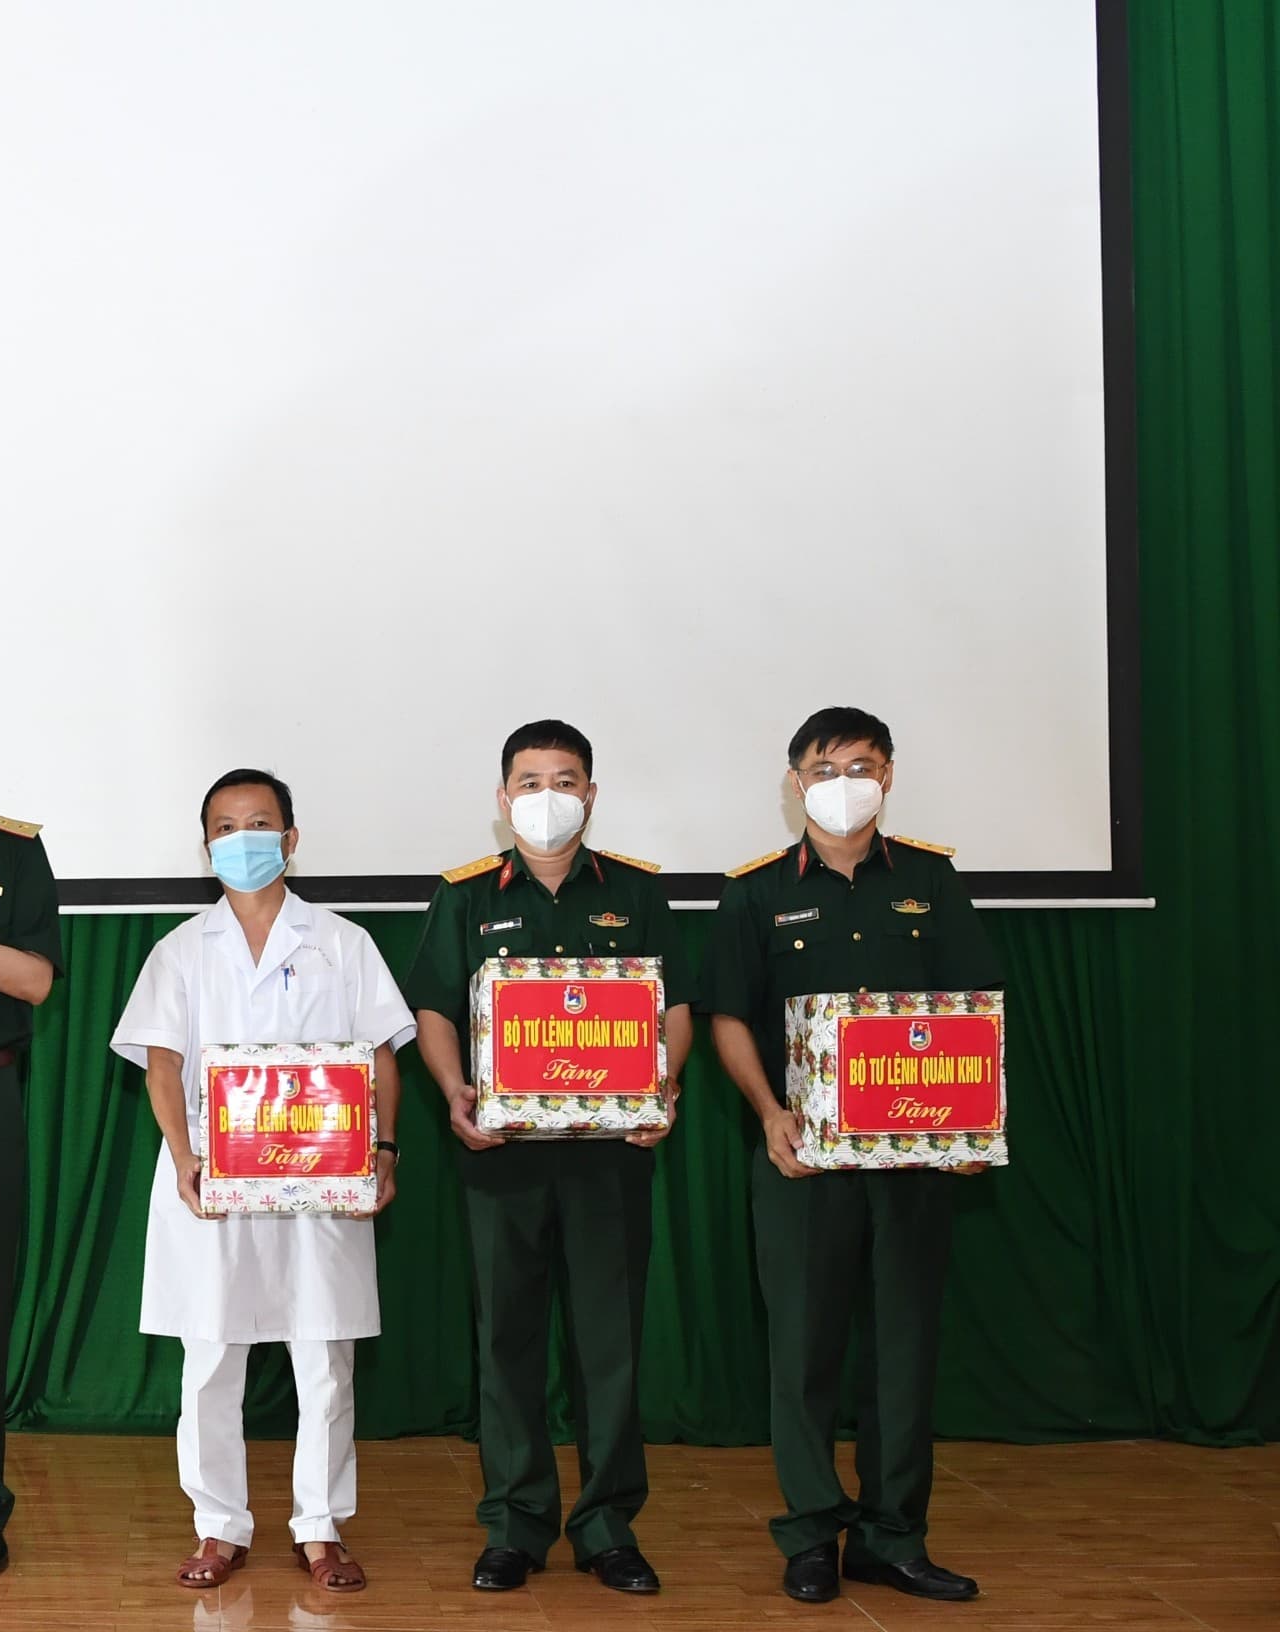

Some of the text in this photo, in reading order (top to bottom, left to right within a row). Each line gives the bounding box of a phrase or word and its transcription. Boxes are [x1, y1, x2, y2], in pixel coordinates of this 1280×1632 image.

[503, 1014, 648, 1053] BỘ TƯ LỆNH QUÂN KHU 1
[542, 1058, 609, 1088] Tặng
[849, 1051, 992, 1092] BỘ TƯ LỆNH QUÂN KHU 1
[326, 1104, 352, 1131] HU
[354, 1104, 361, 1131] 1
[887, 1096, 953, 1126] Tặng
[257, 1143, 322, 1173] Tặng
